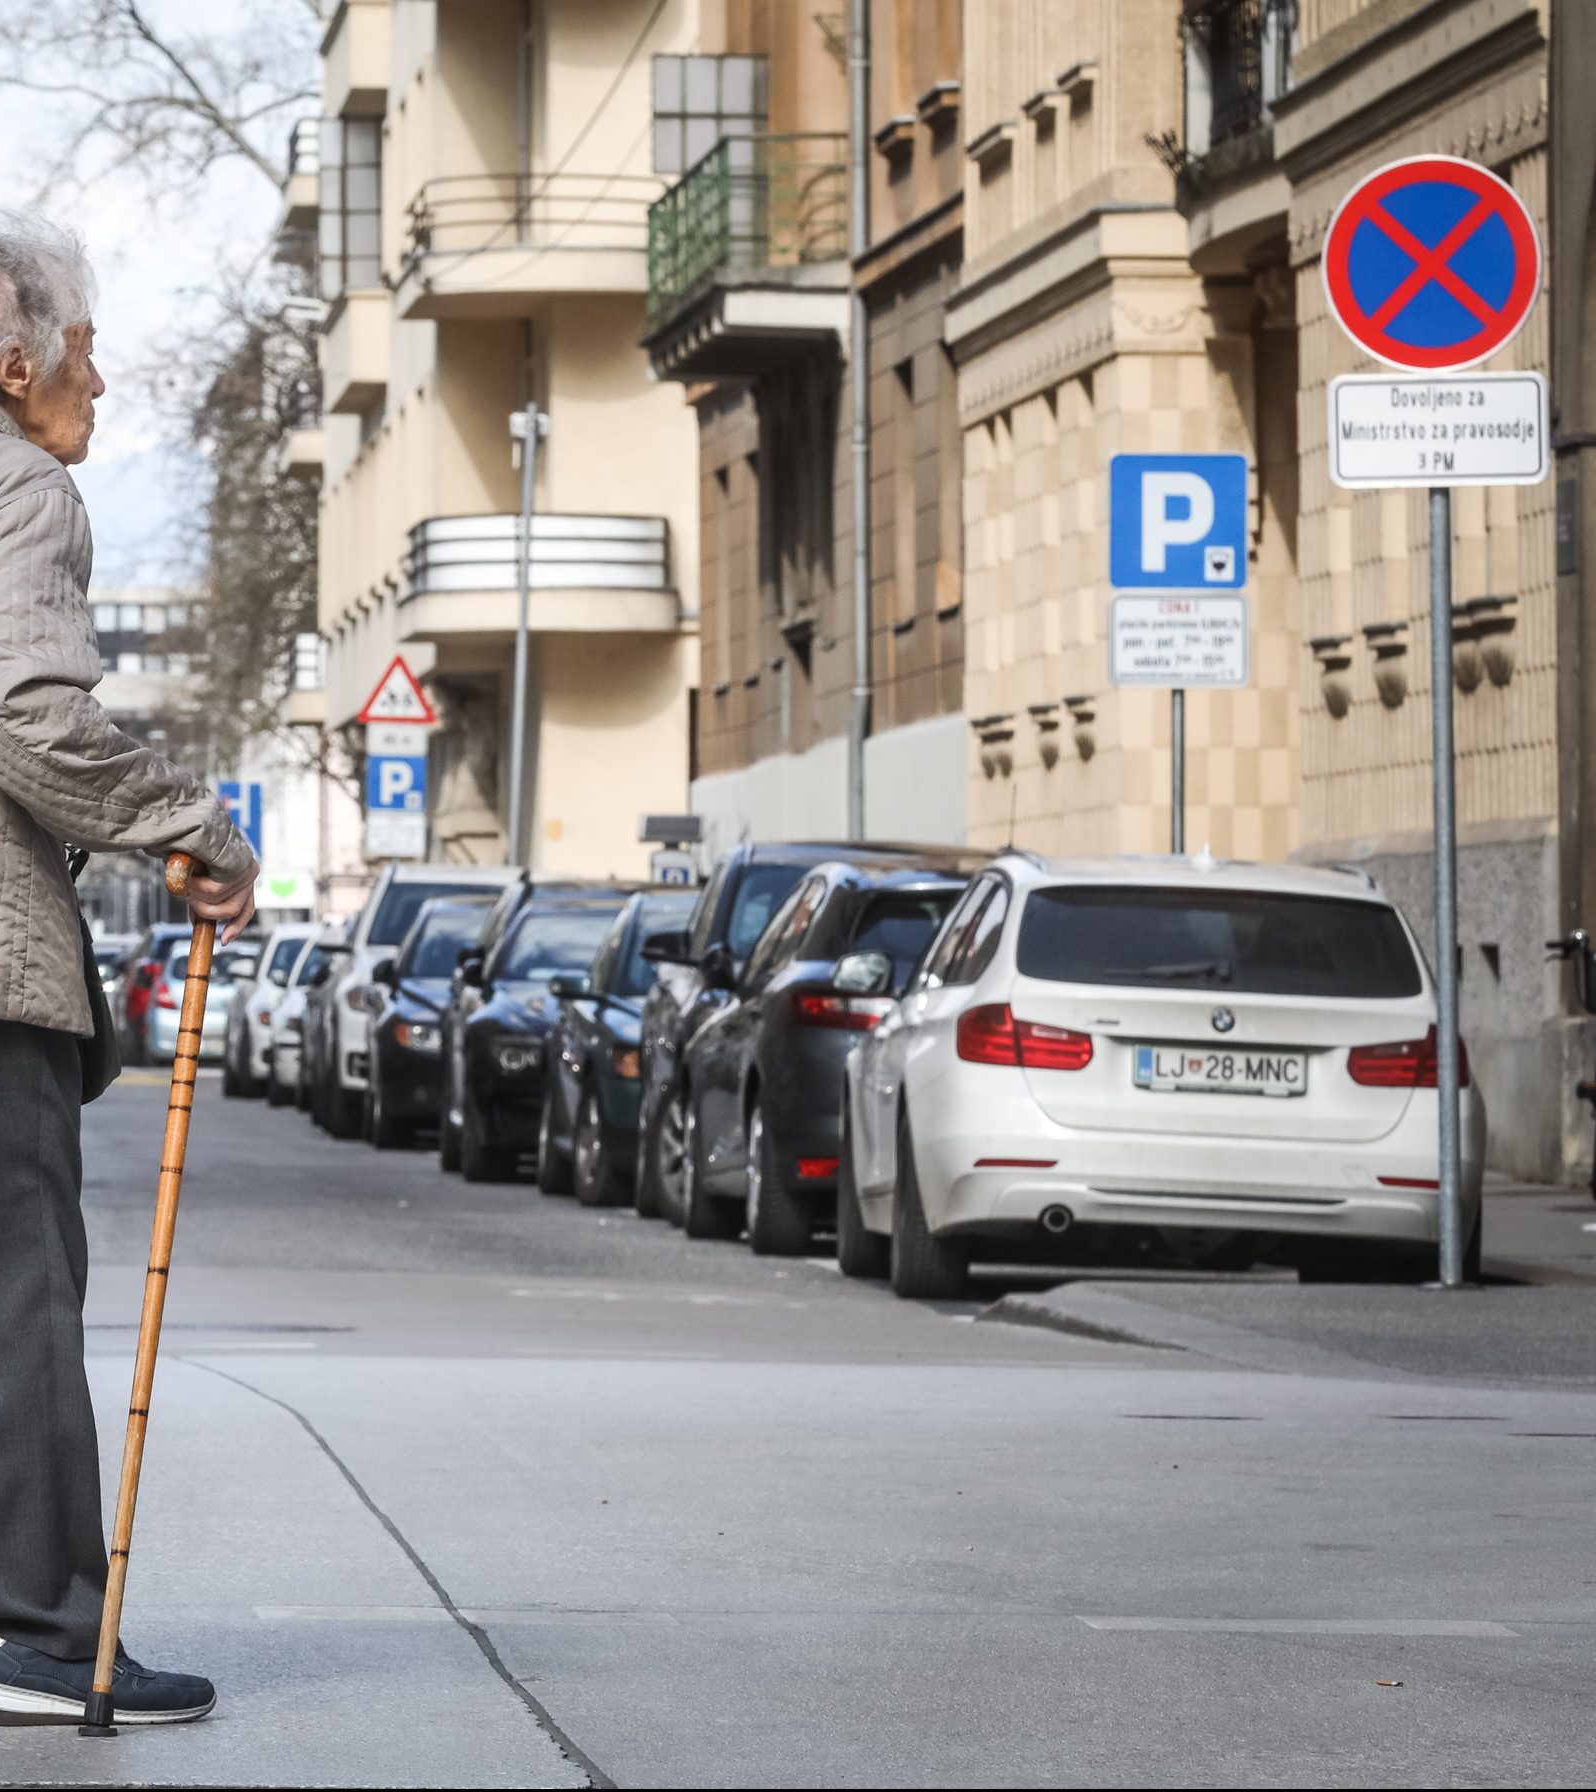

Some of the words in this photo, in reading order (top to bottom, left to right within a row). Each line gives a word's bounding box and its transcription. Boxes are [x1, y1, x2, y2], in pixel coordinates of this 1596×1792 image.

[1390, 387, 1463, 412] Dovoljeno
[1468, 390, 1485, 406] za
[1342, 421, 1426, 441] Ministrstvo
[1432, 425, 1448, 439] za
[1453, 418, 1535, 444] pravosodje
[1418, 452, 1427, 470] 3
[1433, 451, 1455, 471] PM
[1141, 471, 1215, 573] P
[379, 760, 414, 806] P
[1156, 1053, 1185, 1077] LJ
[1205, 1054, 1299, 1083] 28-MNC
